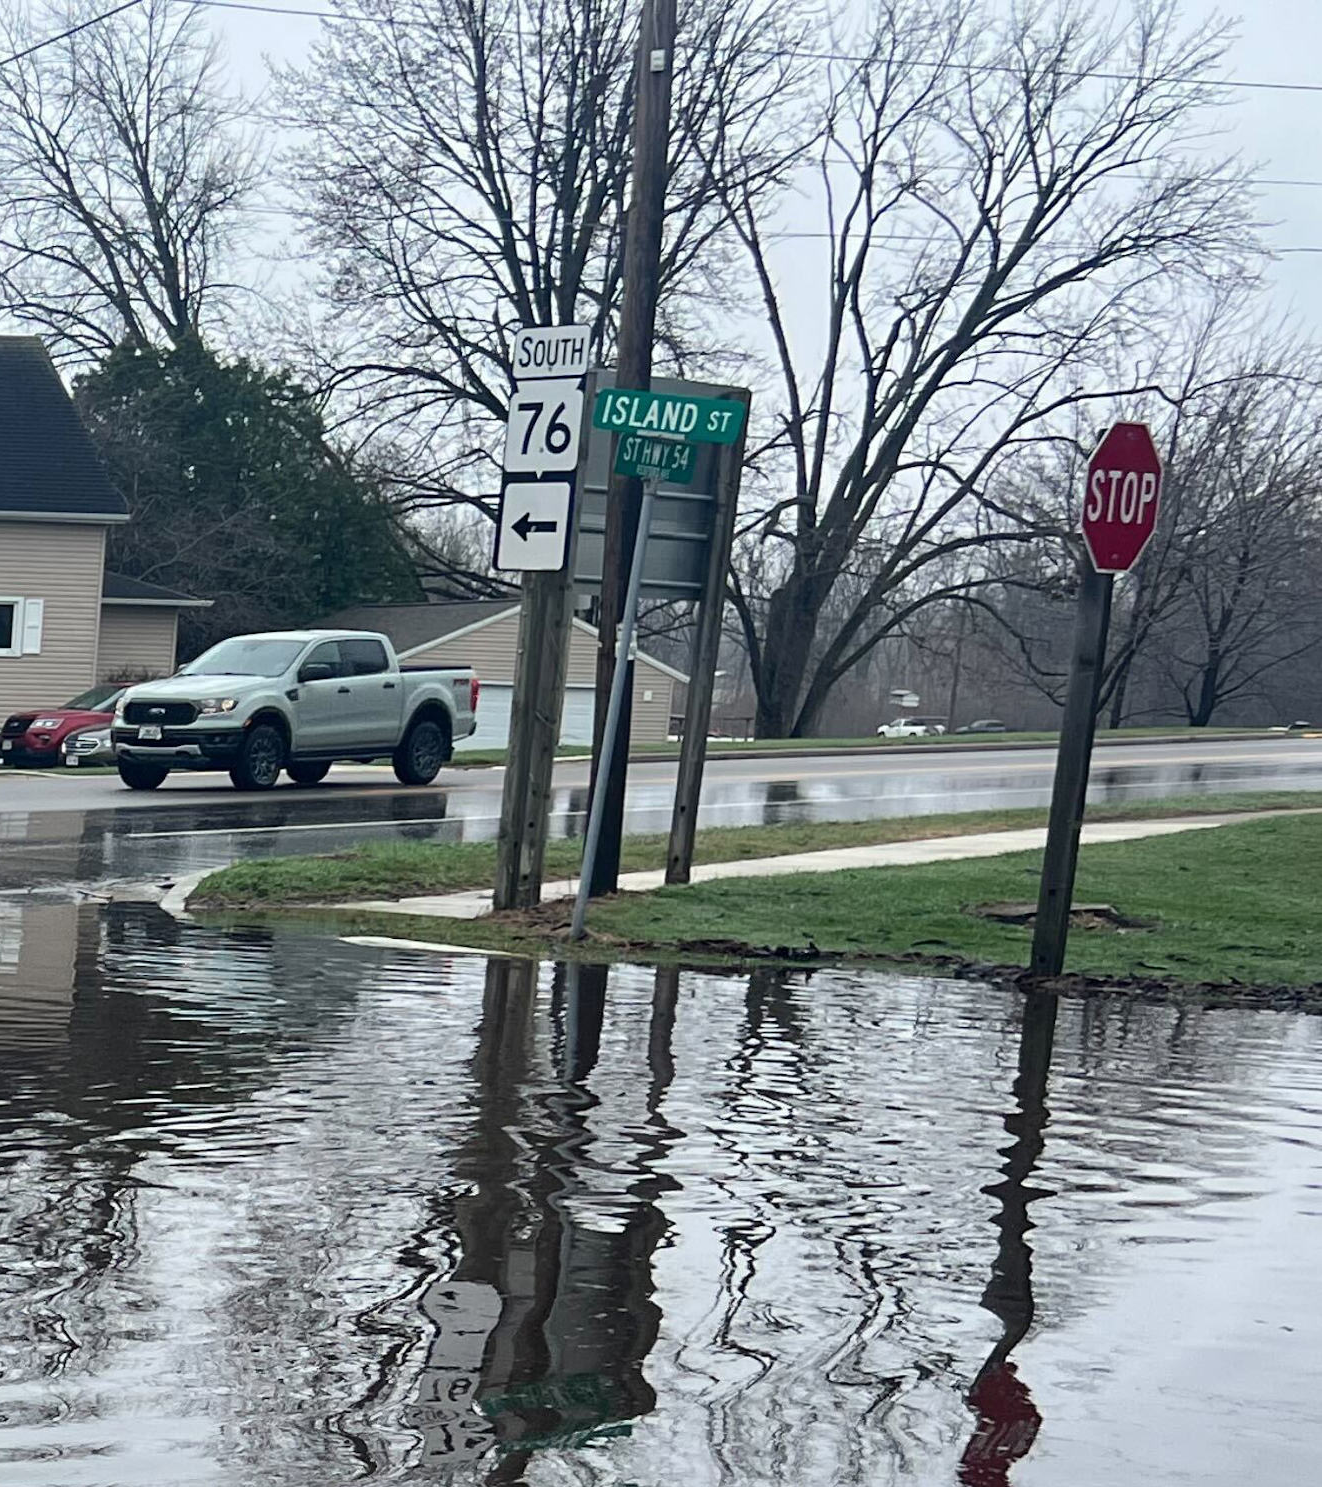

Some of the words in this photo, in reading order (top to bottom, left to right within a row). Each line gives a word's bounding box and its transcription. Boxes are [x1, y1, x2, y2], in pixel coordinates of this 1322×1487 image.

[518, 336, 584, 368] SOUTH
[517, 401, 571, 455] 76
[602, 394, 698, 433] ISLAND
[707, 411, 732, 432] ST
[623, 437, 642, 462] ST
[641, 441, 670, 467] HWY
[672, 445, 690, 470] 54
[1086, 469, 1156, 525] STOP
